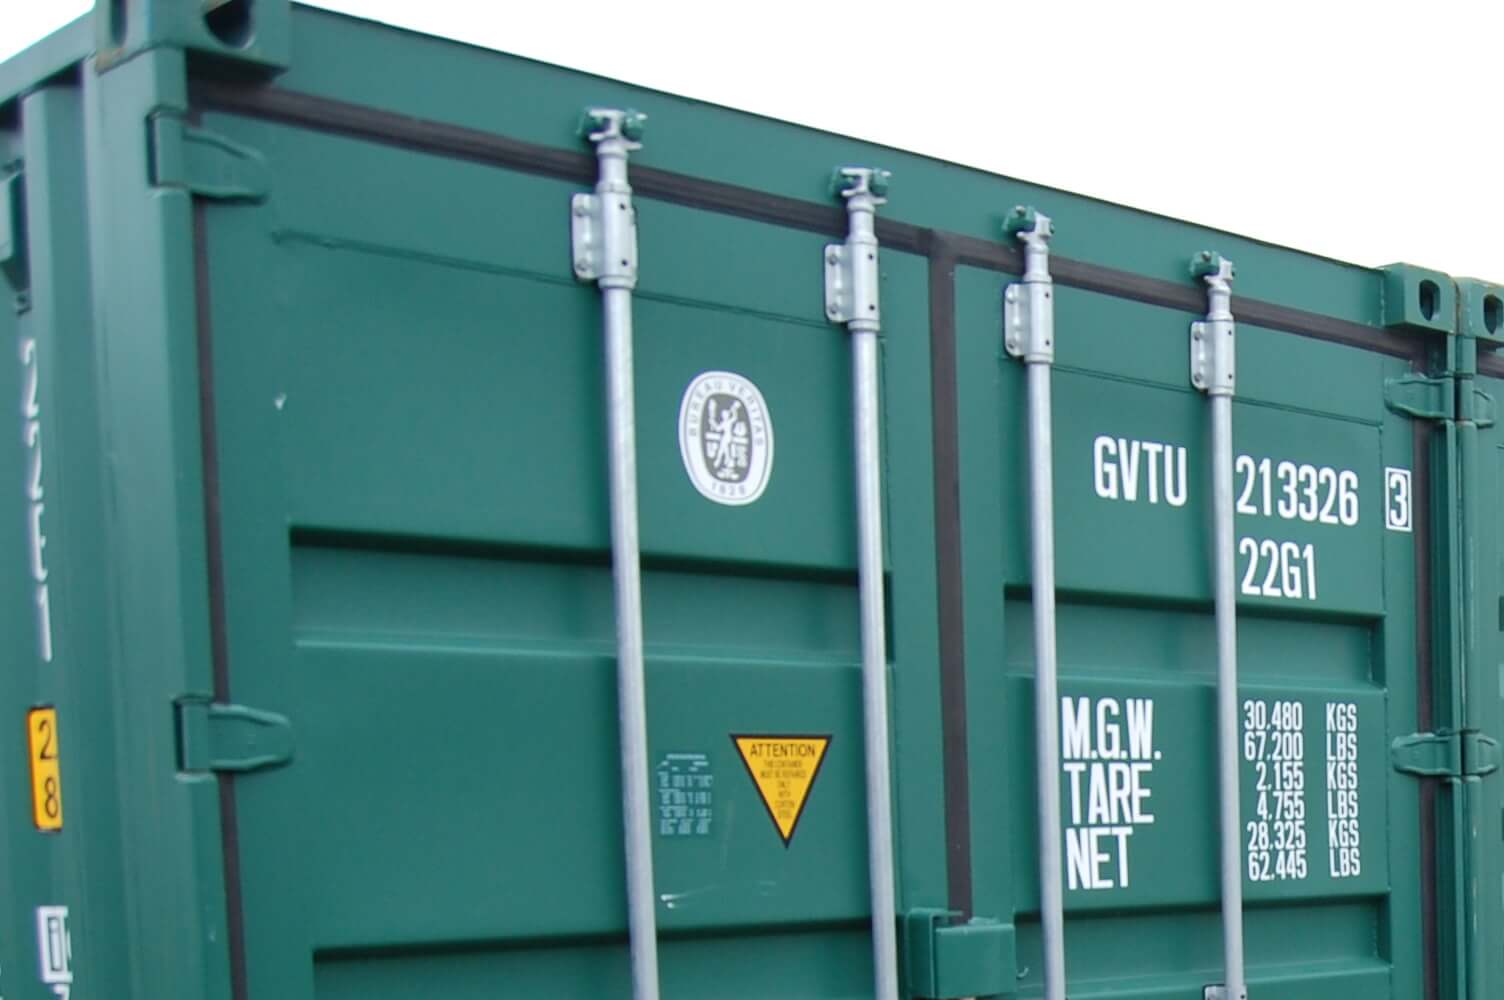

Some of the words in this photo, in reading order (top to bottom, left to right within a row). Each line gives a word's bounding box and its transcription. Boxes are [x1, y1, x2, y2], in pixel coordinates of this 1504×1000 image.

[1093, 435, 1188, 507] GVTU
[1236, 454, 1359, 526] 213326
[1388, 472, 1410, 529] 3
[1240, 537, 1317, 600] 22G1
[750, 743, 816, 757] ATTENTION
[1061, 697, 1162, 760] M.G.W.
[1244, 701, 1303, 731] 30.480
[1326, 703, 1357, 731] KGS
[1244, 732, 1303, 761] 67.200
[1326, 733, 1357, 761] LBS
[1063, 763, 1154, 824] TARE
[1256, 762, 1304, 791] 2.155
[1327, 762, 1358, 790] KGS
[1257, 791, 1305, 820] 4.755
[1327, 791, 1358, 820] LBS
[1065, 826, 1133, 890] NET
[1247, 821, 1306, 851] 28.325
[1328, 819, 1359, 849] KGS
[1248, 850, 1307, 881] 62.445
[1329, 848, 1360, 877] LBS
